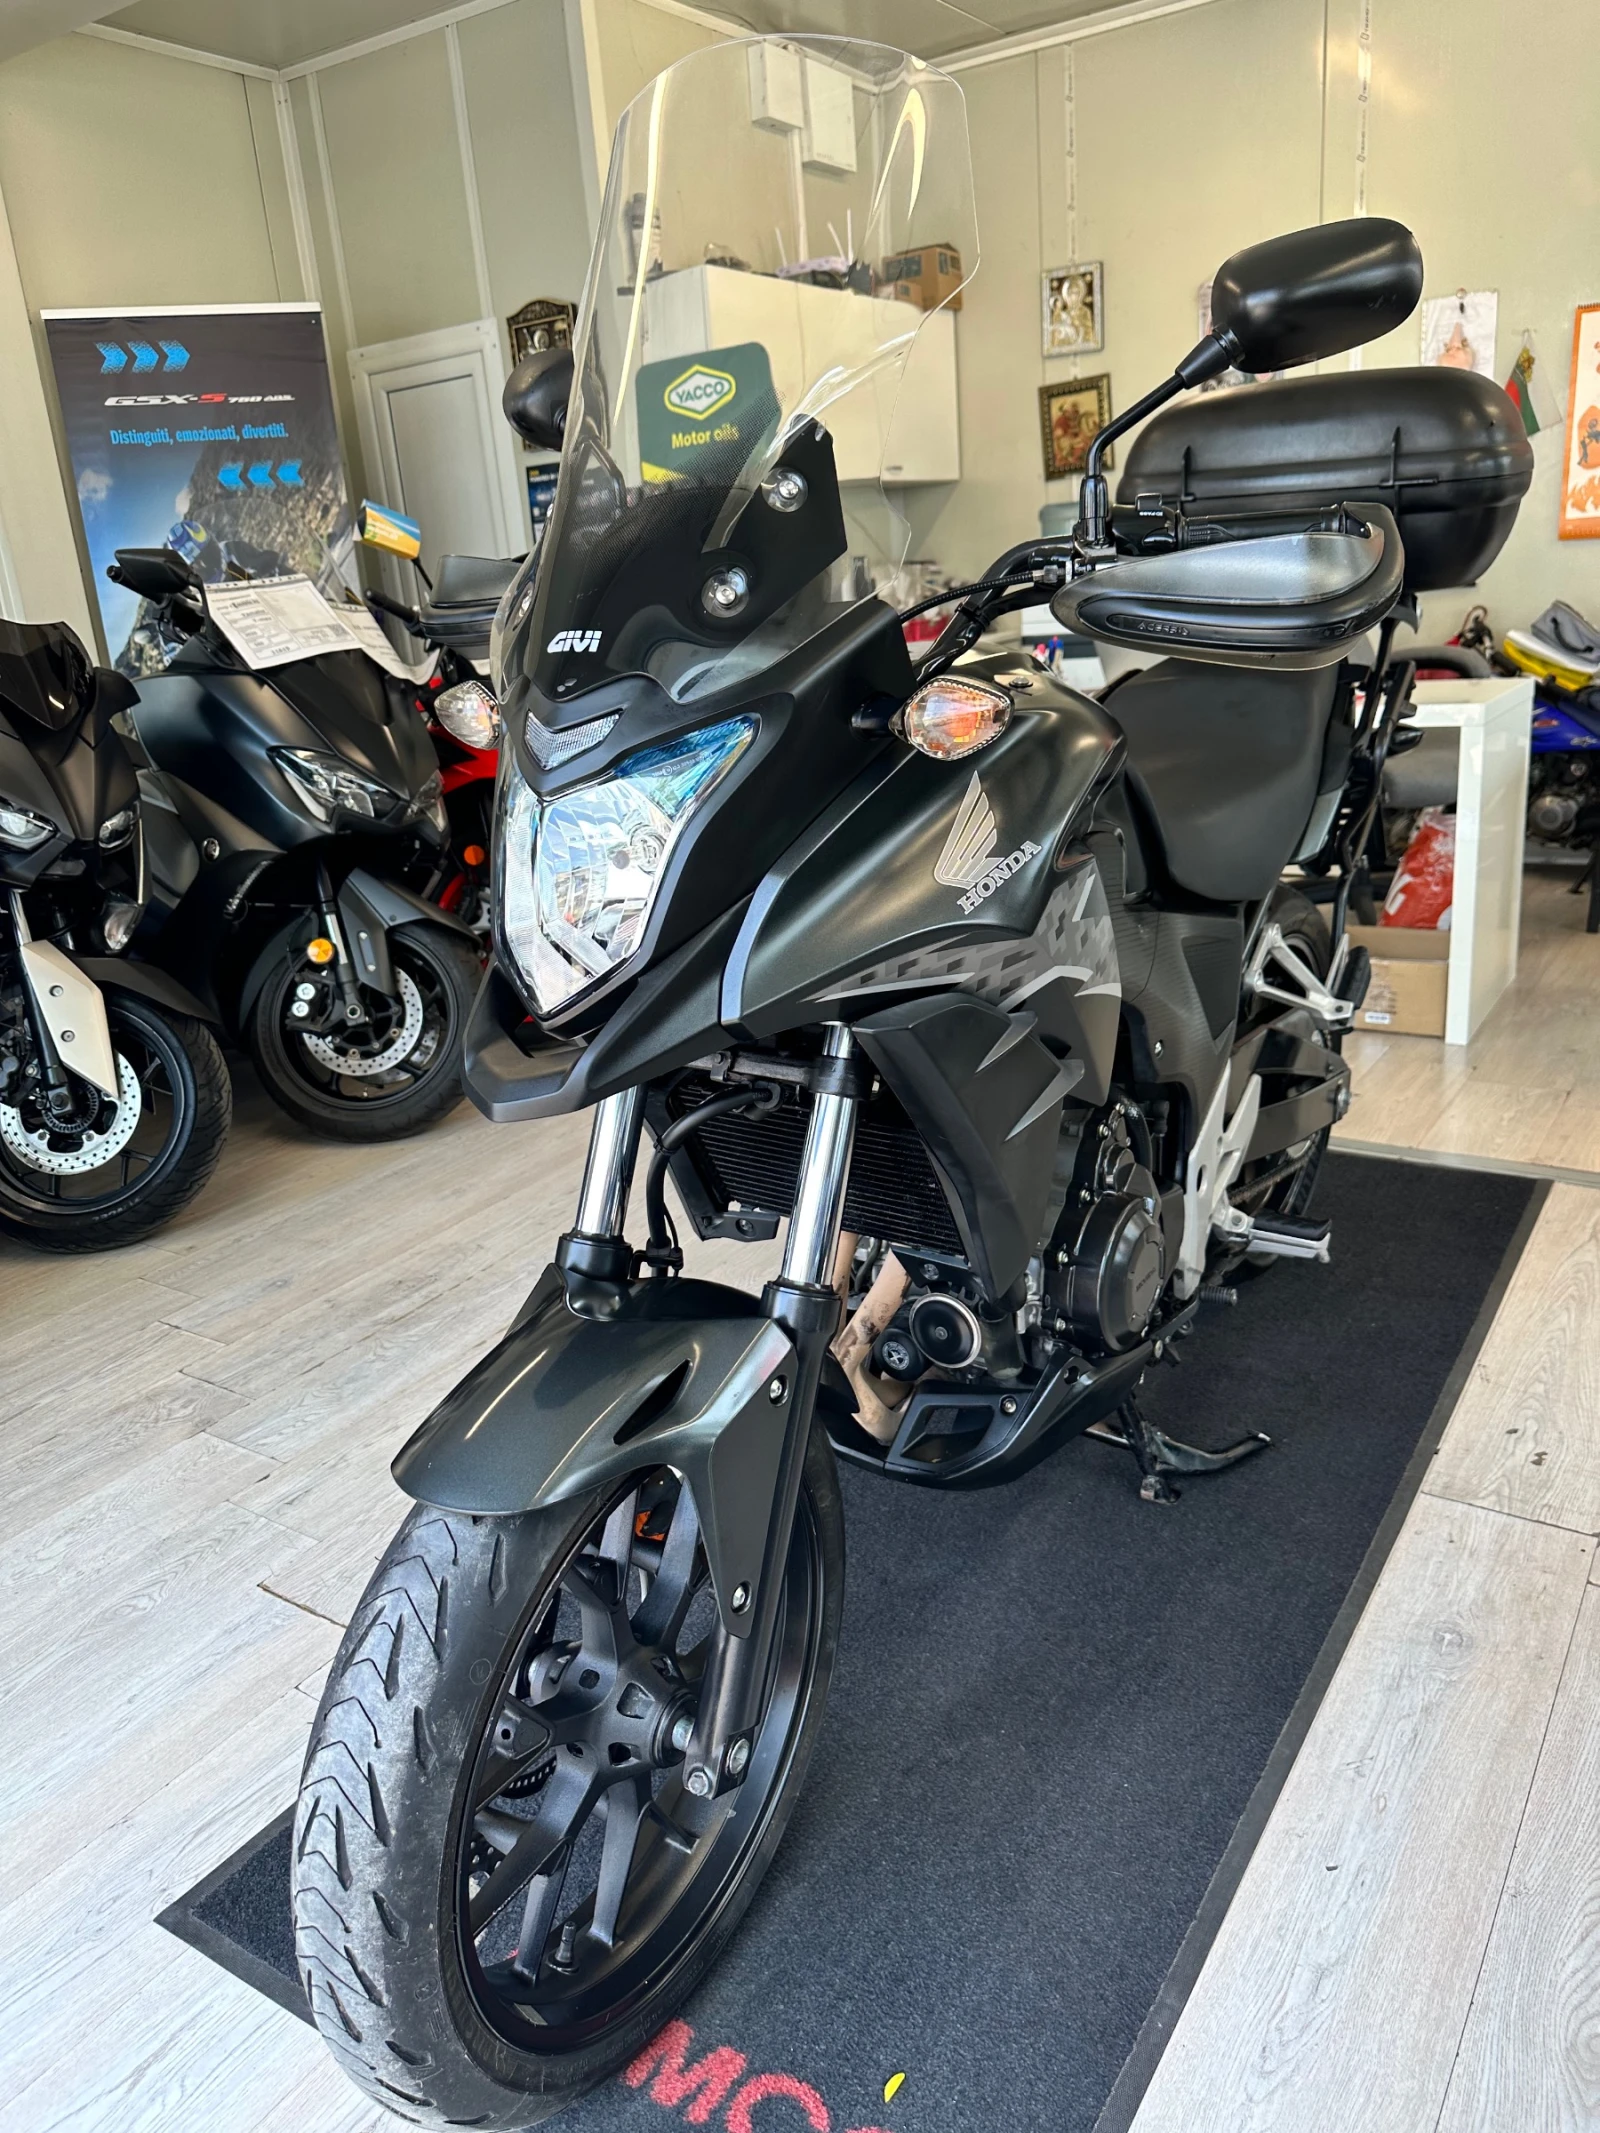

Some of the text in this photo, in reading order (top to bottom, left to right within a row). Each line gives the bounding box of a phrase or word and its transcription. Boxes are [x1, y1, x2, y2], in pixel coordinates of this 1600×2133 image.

[104, 392, 227, 406] GSX-S
[676, 381, 725, 403] YACCO
[110, 422, 289, 447] Distinguiti, emozionati, divertiti.
[671, 422, 739, 449] Motor oils
[547, 630, 602, 653] GIVI
[956, 841, 1042, 915] HONDA
